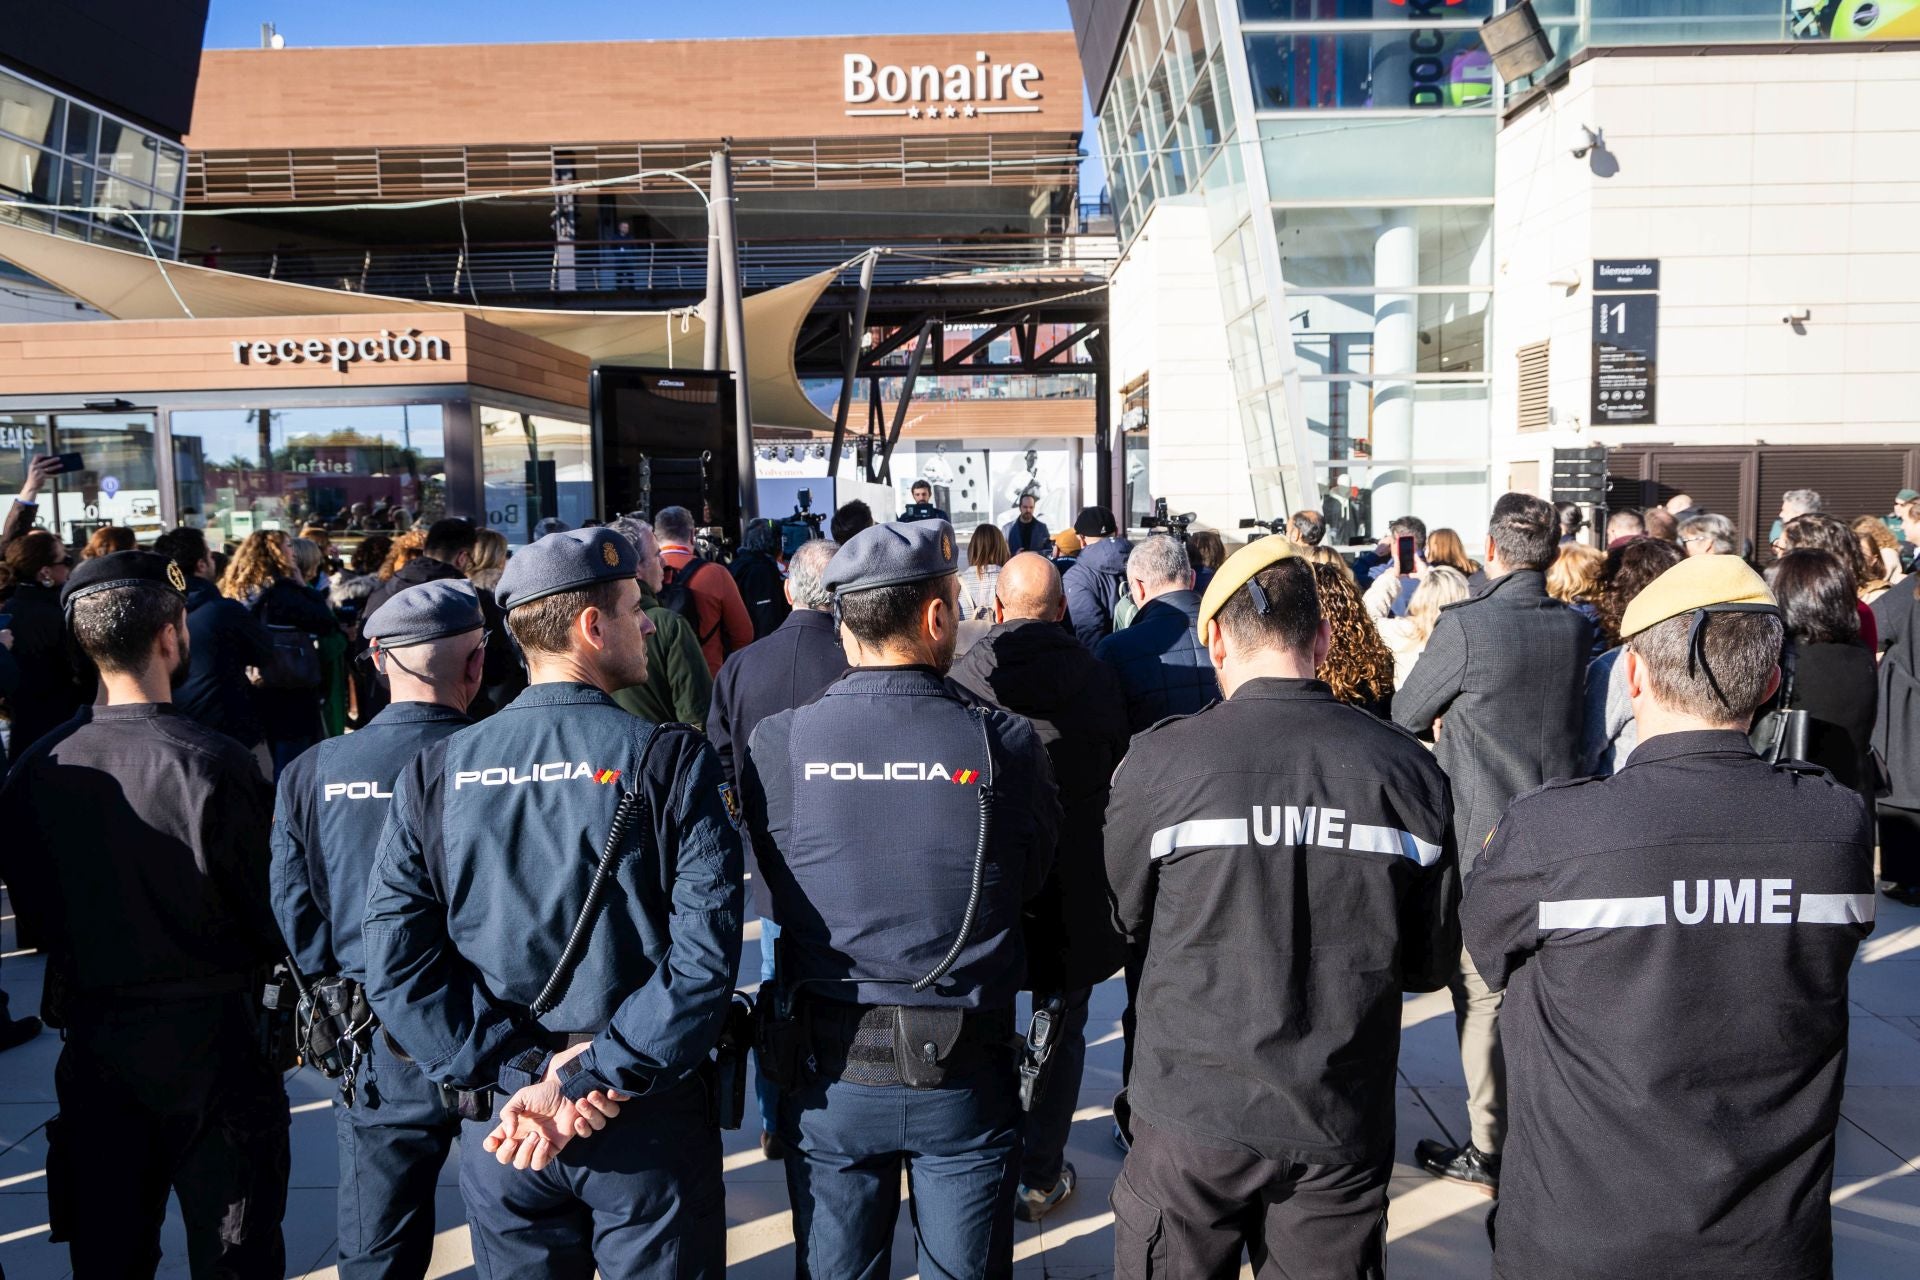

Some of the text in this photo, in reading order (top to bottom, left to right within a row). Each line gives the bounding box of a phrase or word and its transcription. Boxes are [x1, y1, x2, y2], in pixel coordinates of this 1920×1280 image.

[843, 51, 1040, 103] Bonaire
[1600, 264, 1652, 276] bienvenido
[1610, 302, 1626, 334] 1
[231, 328, 447, 372] recepción
[291, 458, 354, 473] lefties
[454, 761, 594, 790] POLICIA
[804, 762, 951, 781] POLICIA
[1252, 805, 1346, 848] UME
[1673, 878, 1792, 925] UME
